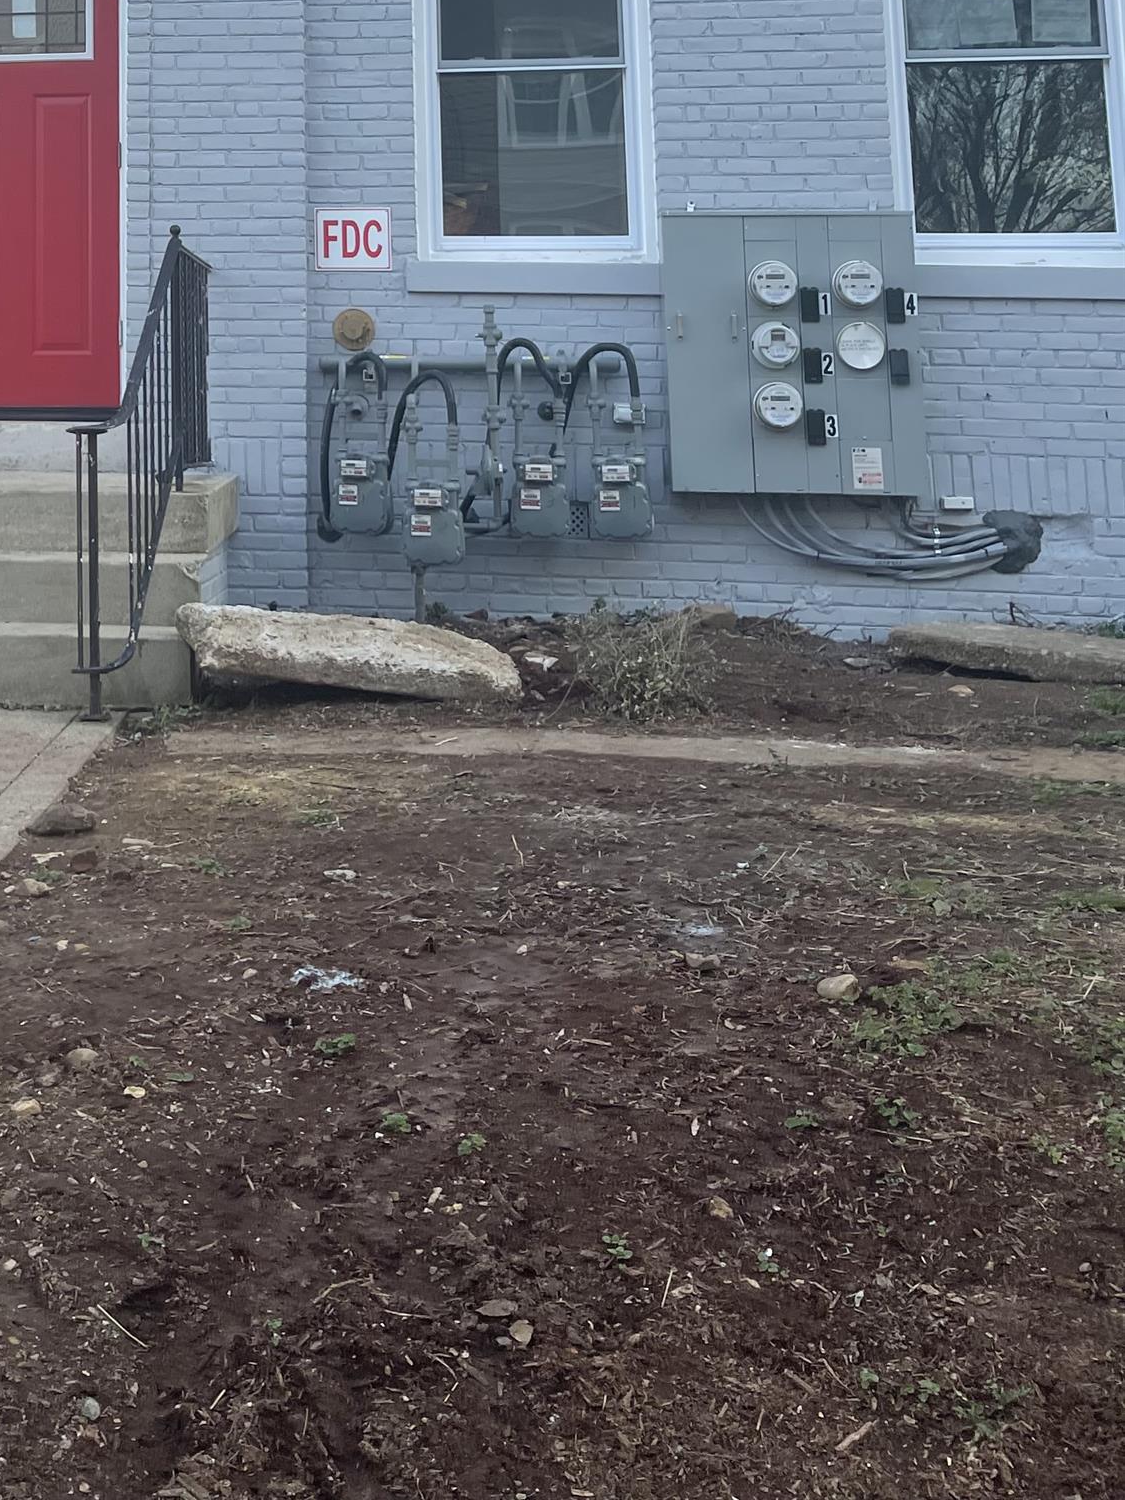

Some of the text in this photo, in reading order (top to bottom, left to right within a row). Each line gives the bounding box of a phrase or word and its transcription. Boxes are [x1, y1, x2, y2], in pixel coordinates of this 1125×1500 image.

[322, 219, 383, 259] FDC
[821, 293, 829, 315] 1
[906, 293, 916, 315] 4
[822, 354, 833, 375] 2
[826, 415, 836, 437] 3
